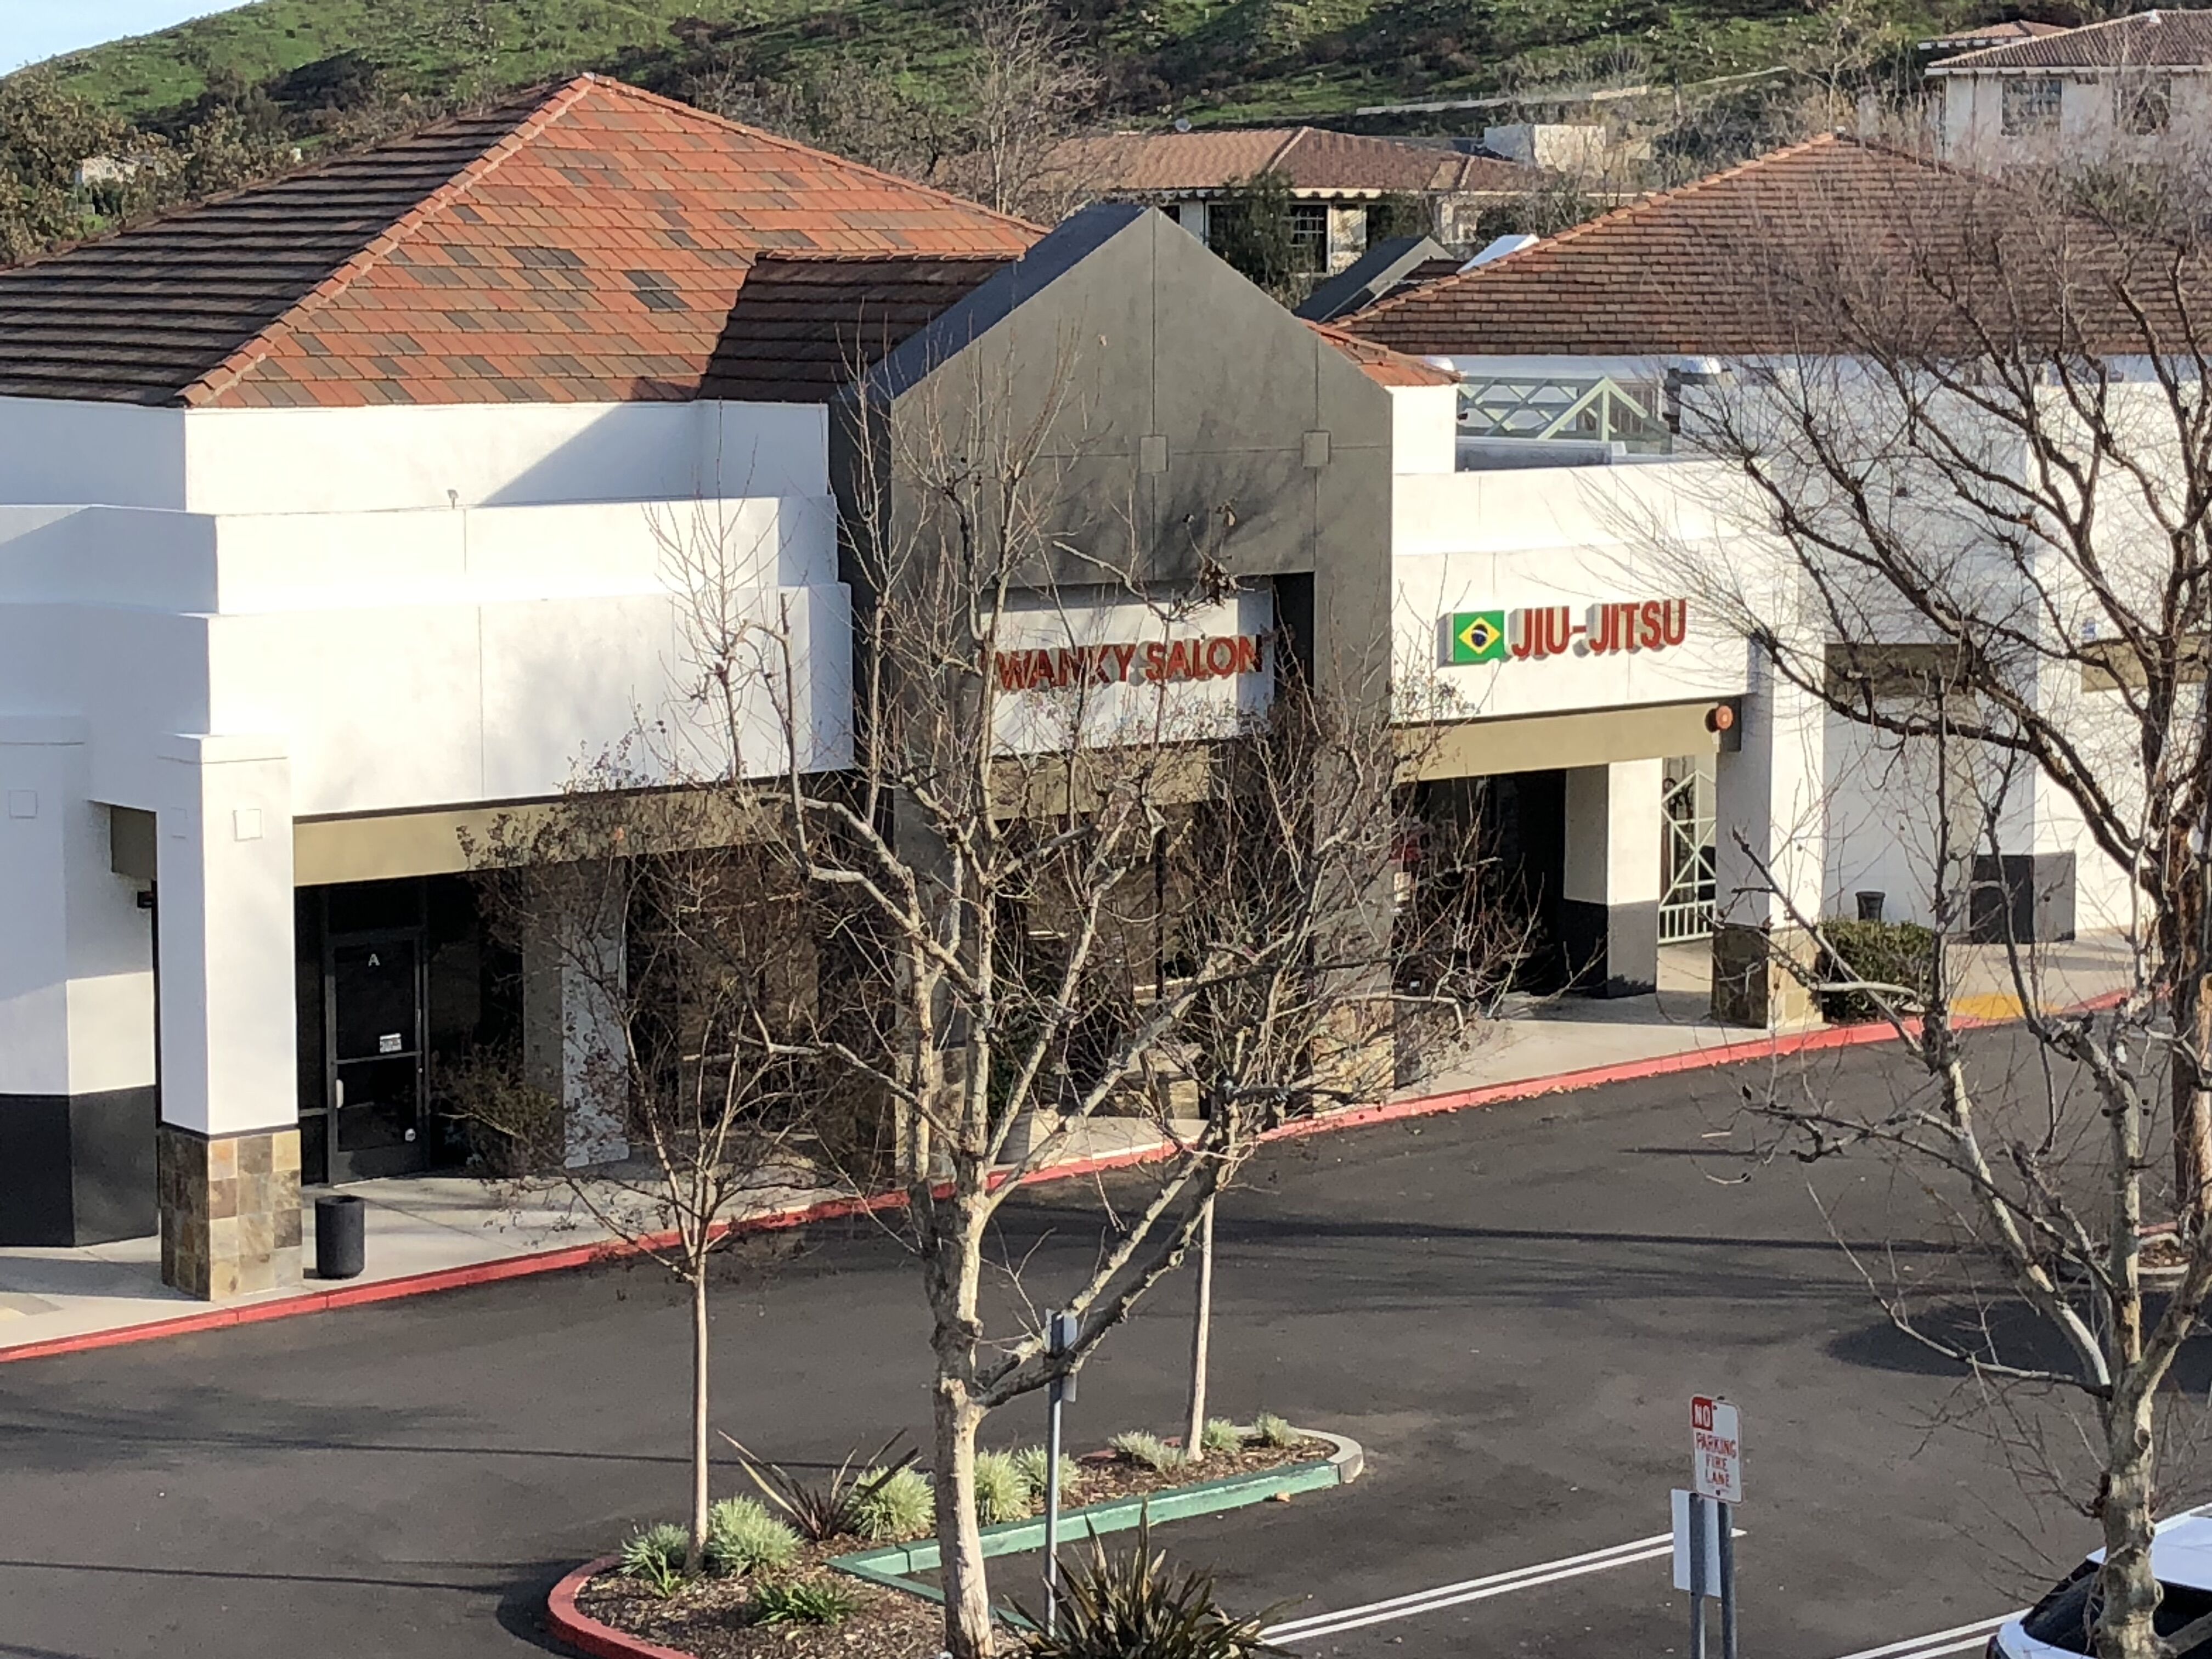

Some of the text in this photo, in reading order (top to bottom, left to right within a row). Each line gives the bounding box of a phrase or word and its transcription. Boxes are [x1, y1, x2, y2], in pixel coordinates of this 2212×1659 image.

[1511, 599, 1686, 657] JIU-JITSU
[980, 634, 1262, 691] WANKY SALON
[368, 953, 380, 967] A
[1694, 1404, 1711, 1427] NO
[1696, 1432, 1736, 1459] PARKING
[1706, 1455, 1728, 1472] FIRE
[1706, 1468, 1731, 1487] LANE
